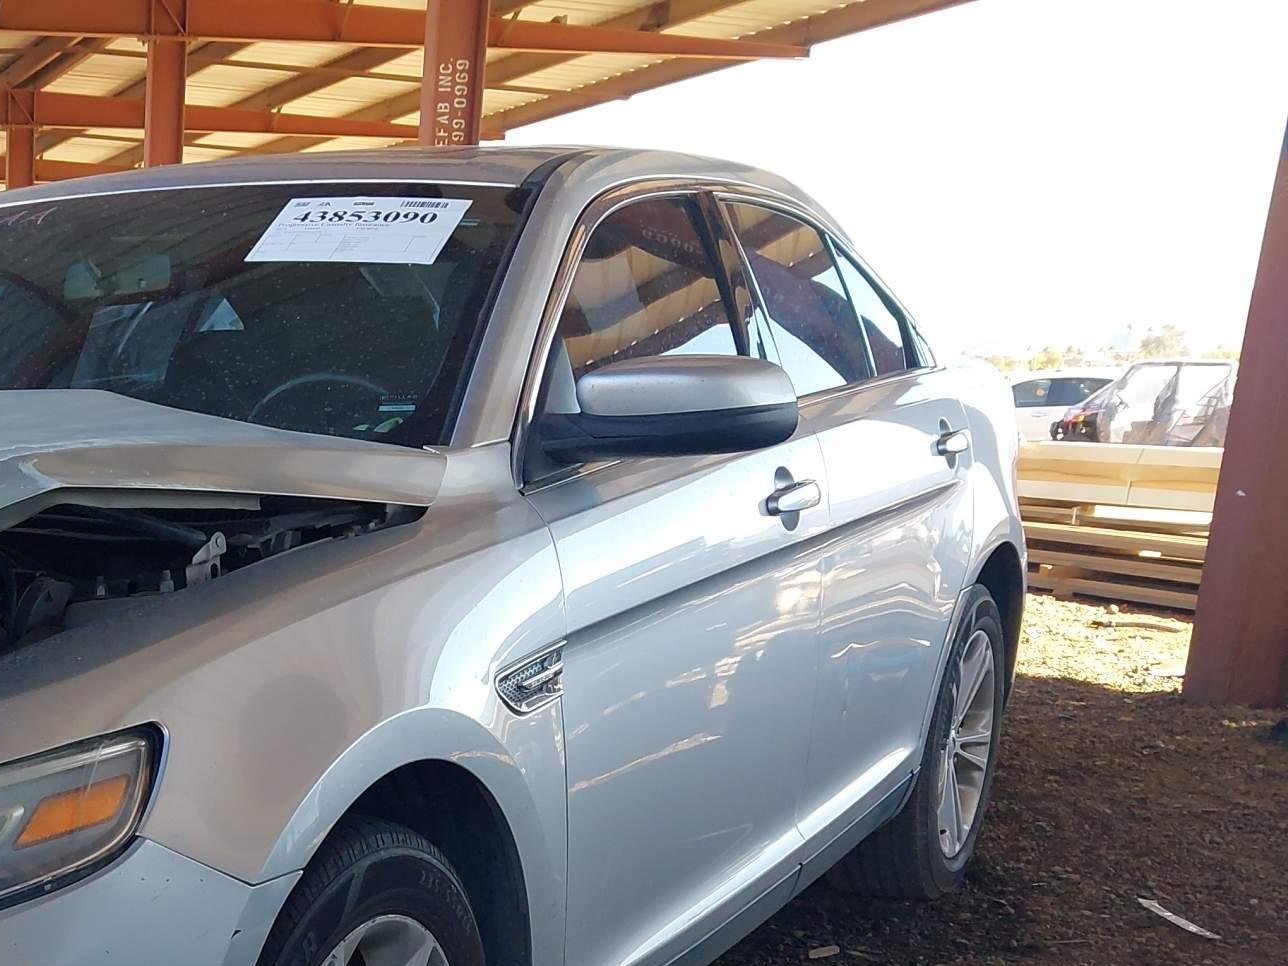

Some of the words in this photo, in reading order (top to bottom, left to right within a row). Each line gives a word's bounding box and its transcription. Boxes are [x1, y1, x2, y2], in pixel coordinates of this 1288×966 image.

[437, 57, 454, 92] INC.
[451, 59, 470, 142] 99-0969
[292, 210, 438, 224] 43853090
